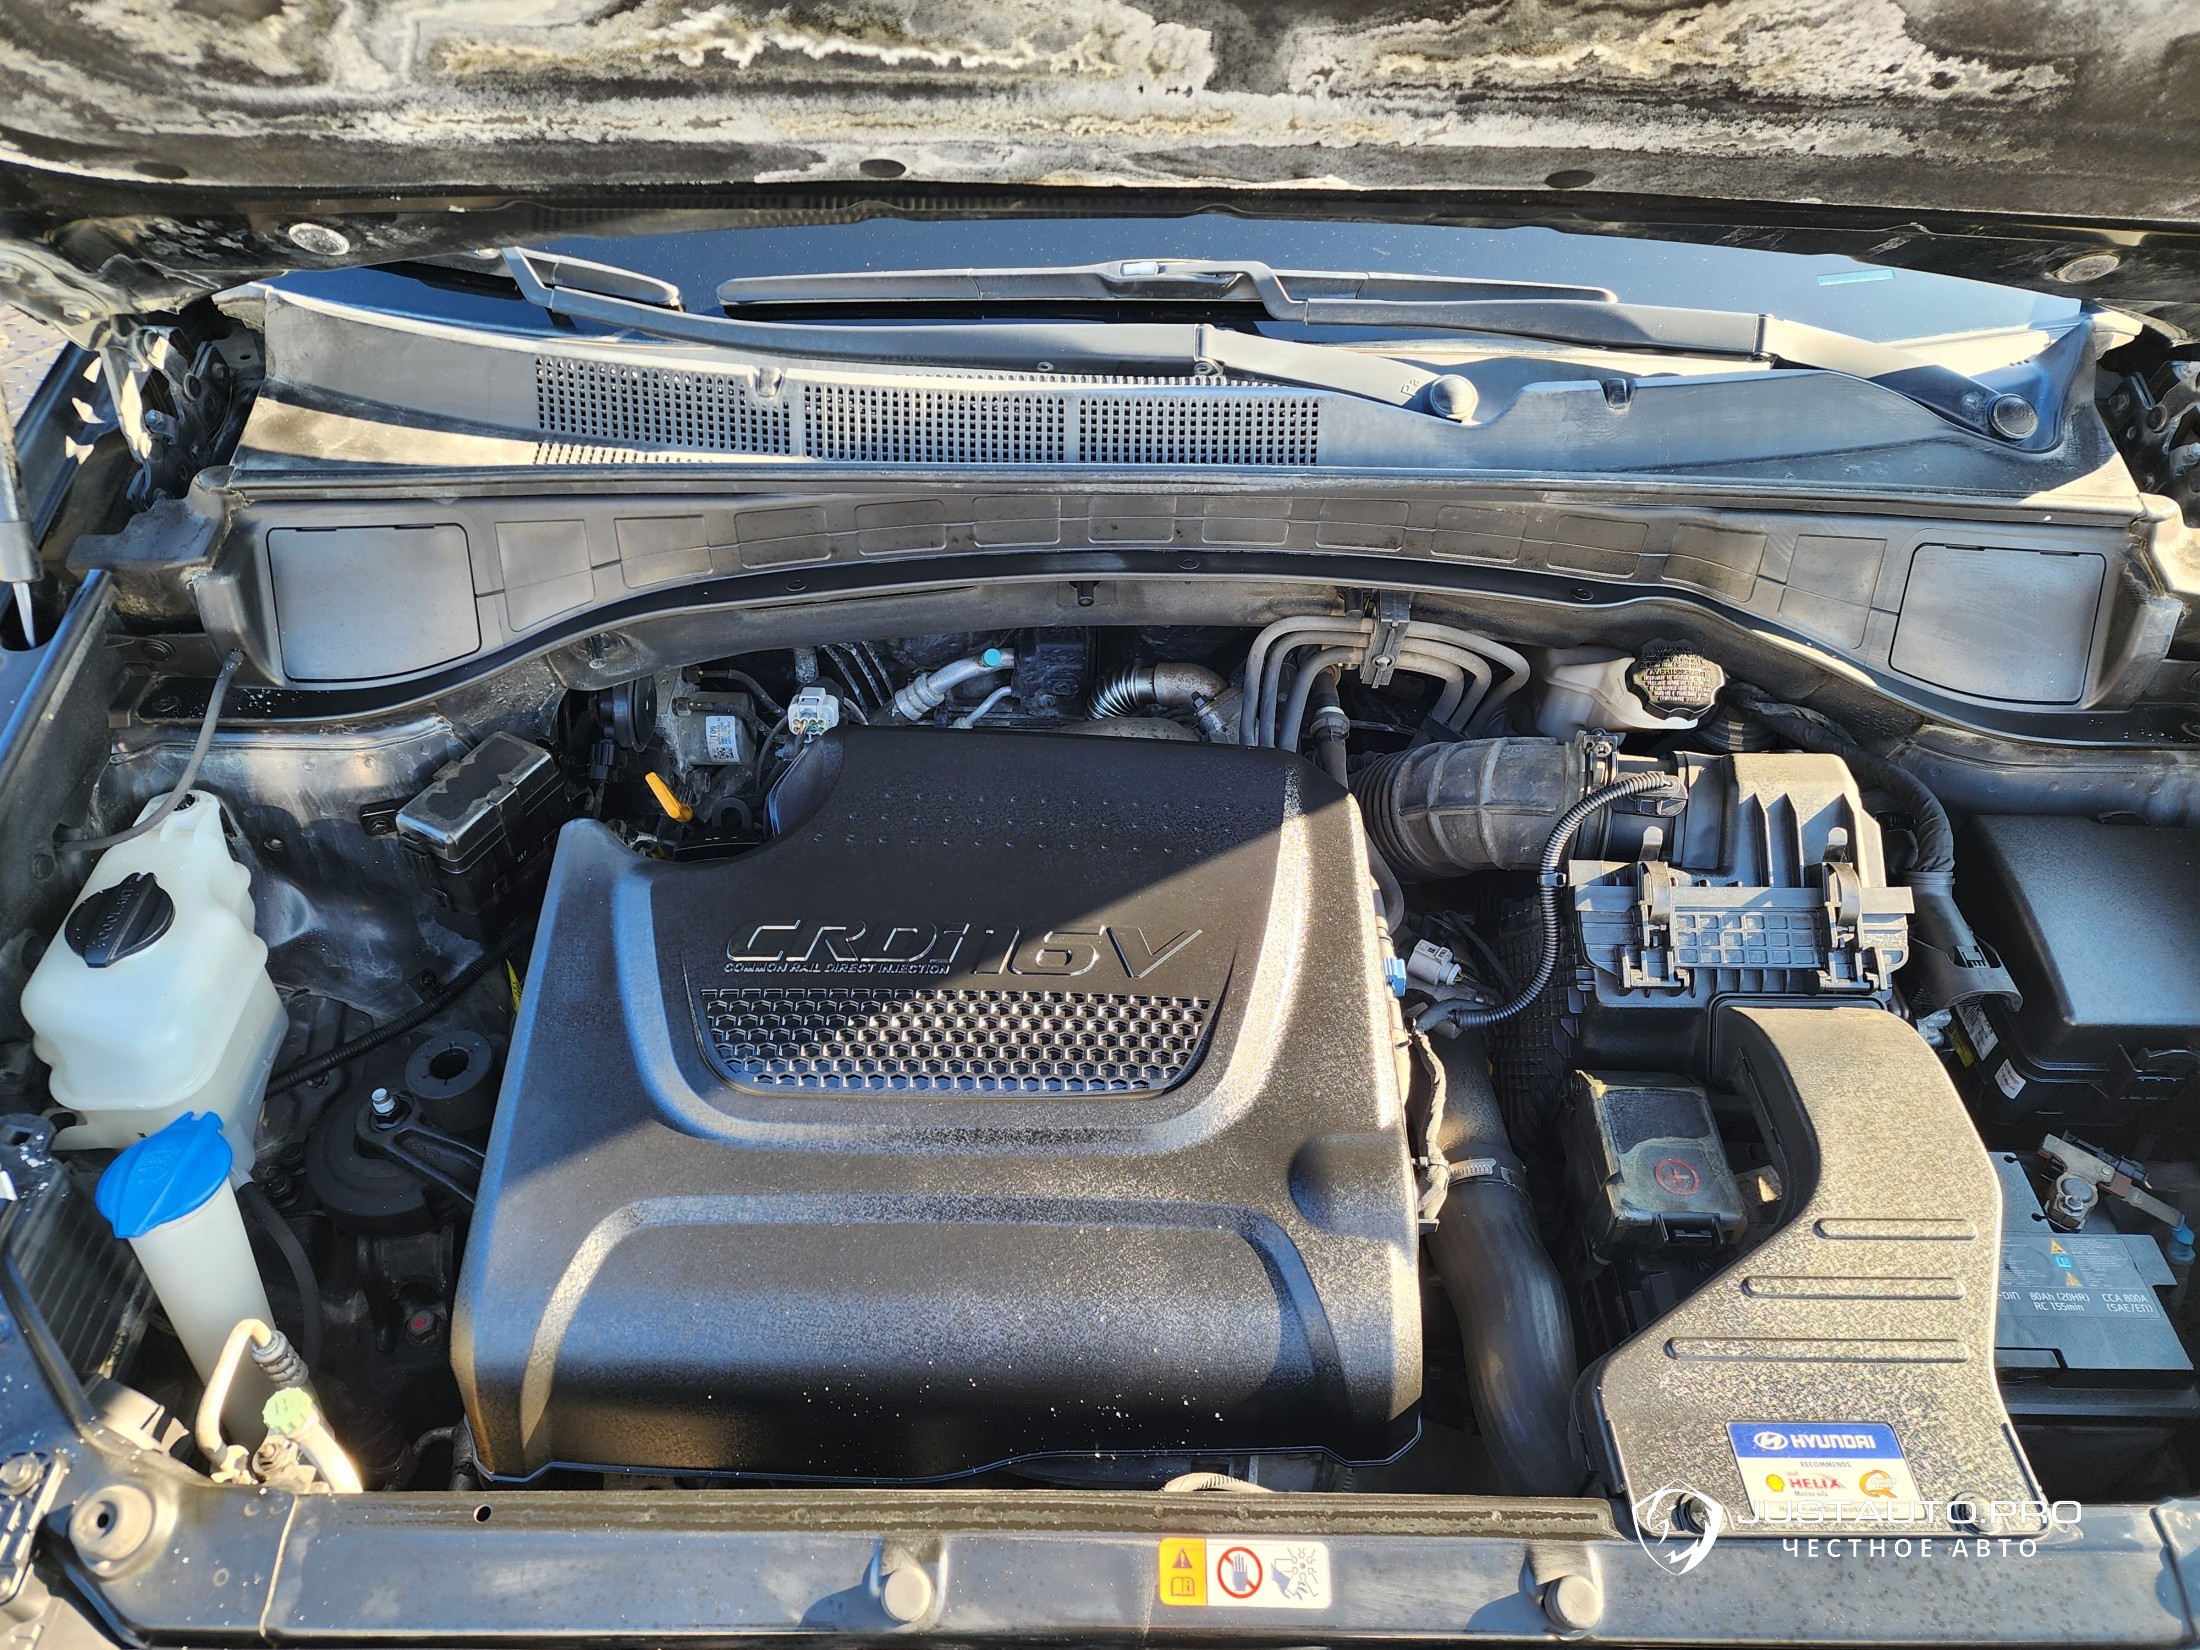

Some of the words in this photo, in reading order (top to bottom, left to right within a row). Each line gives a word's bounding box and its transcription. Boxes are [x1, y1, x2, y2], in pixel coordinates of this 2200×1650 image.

[98, 889, 134, 940] COOLANT
[970, 922, 1203, 978] 16V
[724, 963, 788, 973] COMMON
[790, 963, 821, 973] RAIL
[824, 963, 876, 974] DIRECT
[877, 964, 951, 975] INJECTION
[2029, 1291, 2054, 1301] 80Ah
[2056, 1292, 2090, 1302] (20HR)
[2102, 1293, 2121, 1303] CCA
[2123, 1293, 2149, 1303] 800A
[2033, 1301, 2049, 1311] RC
[2051, 1302, 2085, 1312] 155min
[2107, 1303, 2154, 1313] (SAE/EN)
[1789, 1434, 1877, 1449] HYUNDAI
[1788, 1478, 1842, 1489] HELIX
